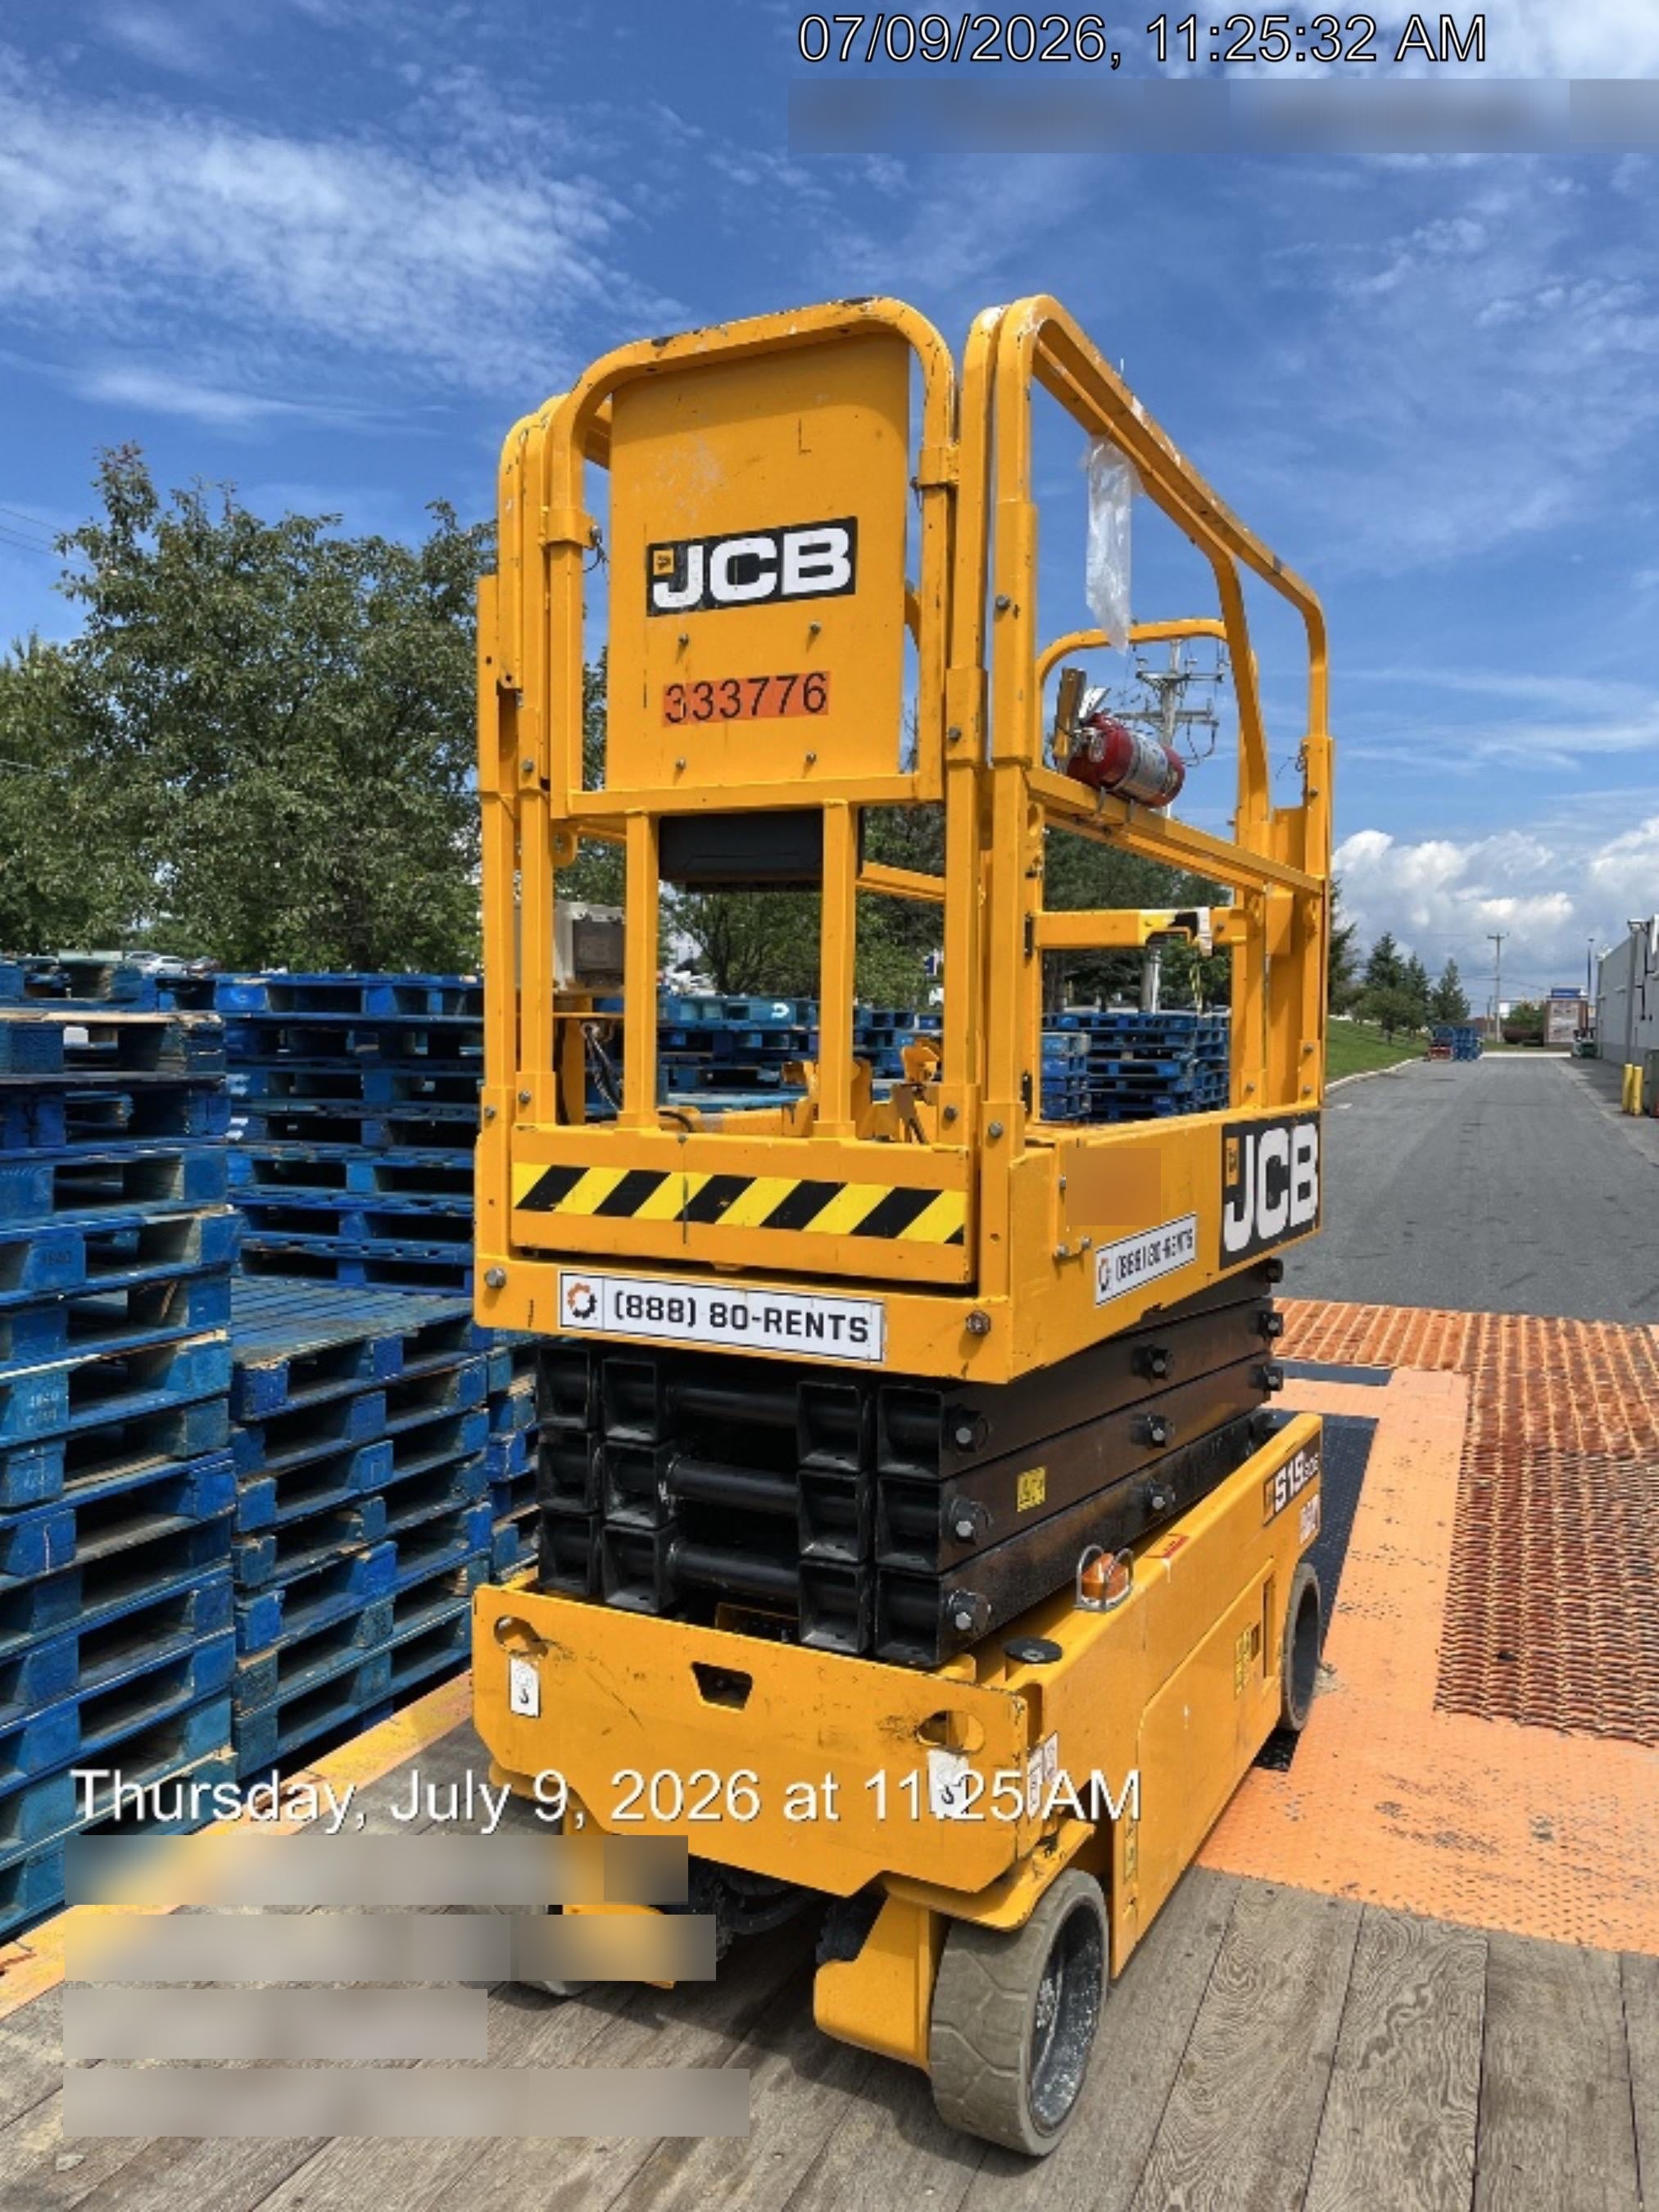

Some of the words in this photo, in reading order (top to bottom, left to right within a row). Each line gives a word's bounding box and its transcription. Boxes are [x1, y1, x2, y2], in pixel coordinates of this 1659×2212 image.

[653, 527, 851, 608] JCB
[665, 673, 827, 723] 333776
[1223, 1122, 1318, 1252] JCB
[614, 1290, 696, 1327] (888)
[709, 1302, 868, 1343] 80-RENTS
